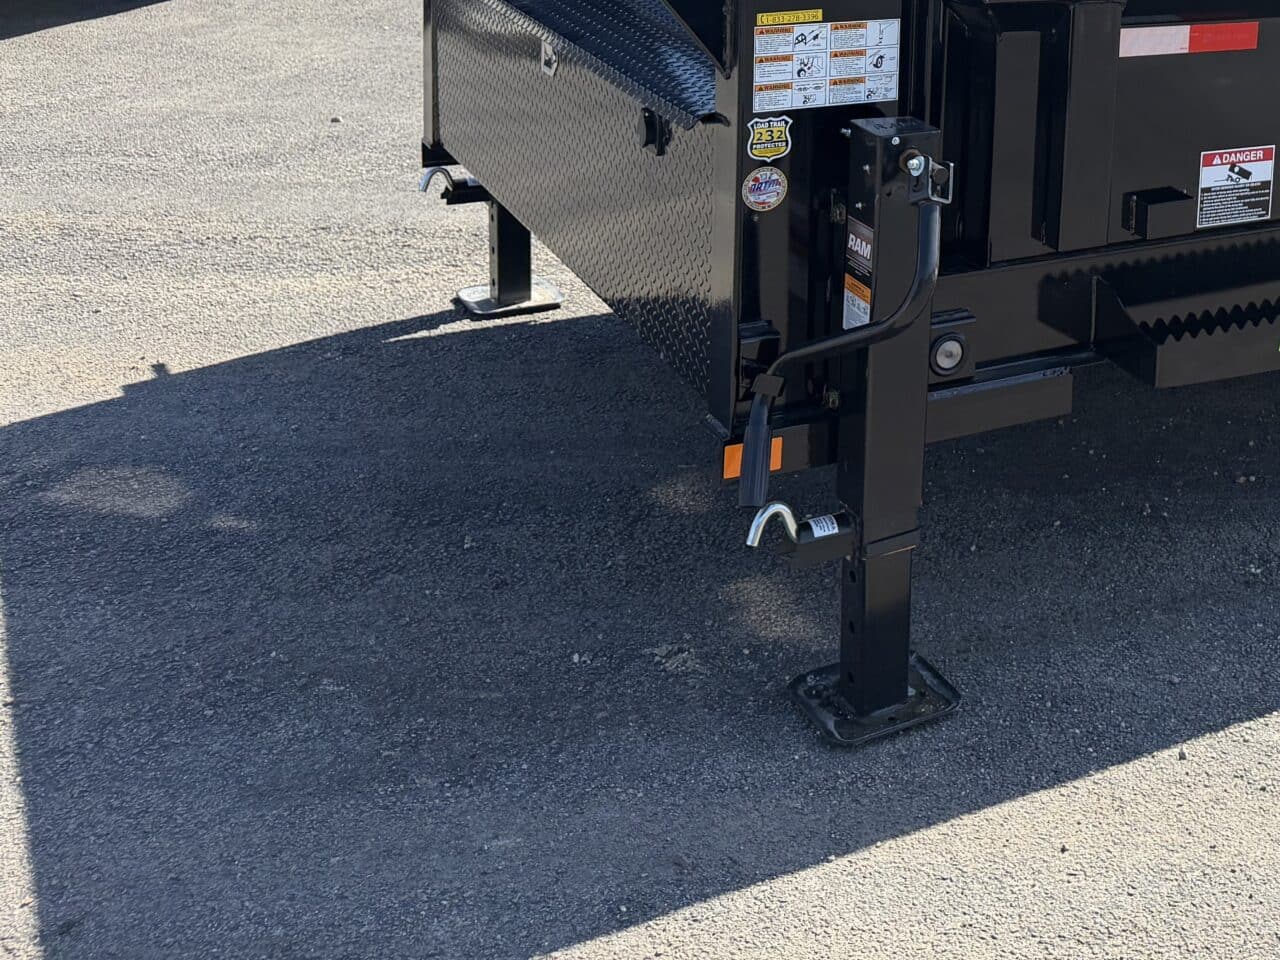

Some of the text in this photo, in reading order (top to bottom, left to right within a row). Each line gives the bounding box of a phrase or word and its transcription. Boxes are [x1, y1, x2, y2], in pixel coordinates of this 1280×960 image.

[769, 120, 786, 128] TRAIL
[756, 130, 784, 142] 232
[1222, 150, 1264, 164] DANGER
[847, 233, 872, 260] RAM
